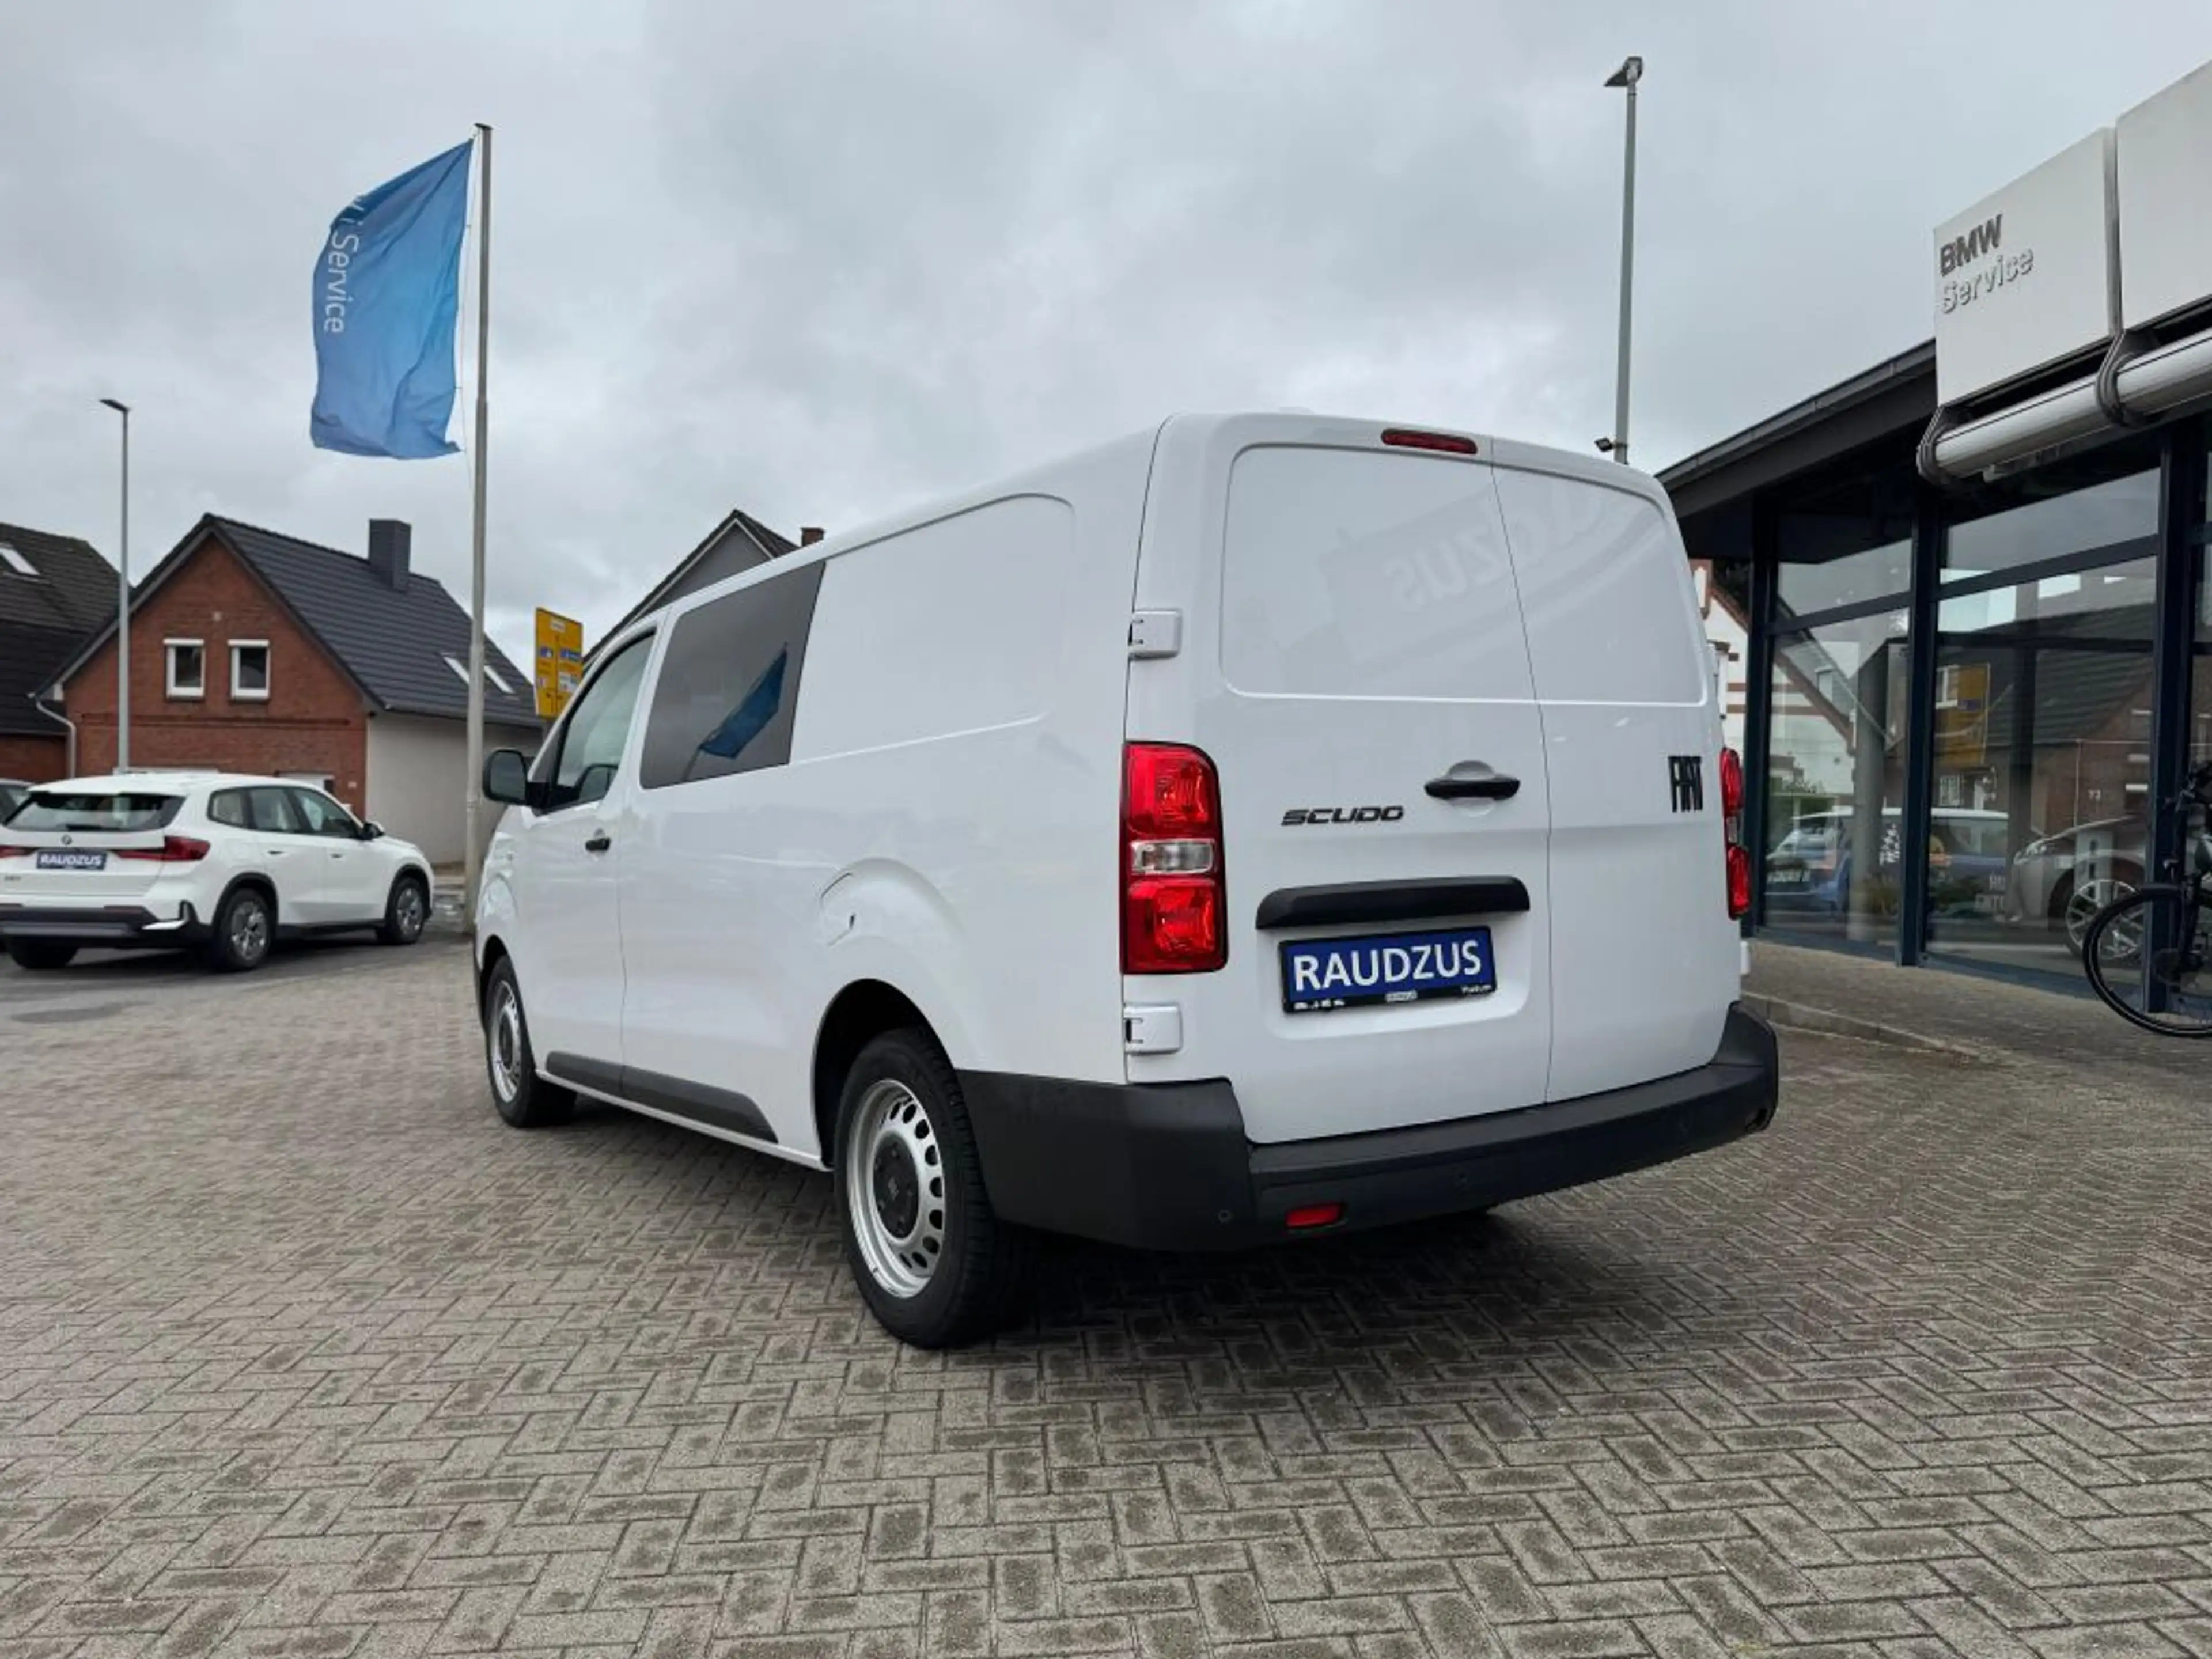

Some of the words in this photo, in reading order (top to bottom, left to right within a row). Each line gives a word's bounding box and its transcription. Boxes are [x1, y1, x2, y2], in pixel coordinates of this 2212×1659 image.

[1940, 214, 2003, 277] BMW
[324, 230, 360, 333] Service
[1941, 249, 2034, 315] Service
[1281, 805, 1404, 826] SCUDO
[1293, 940, 1483, 991] RAUDZUS
